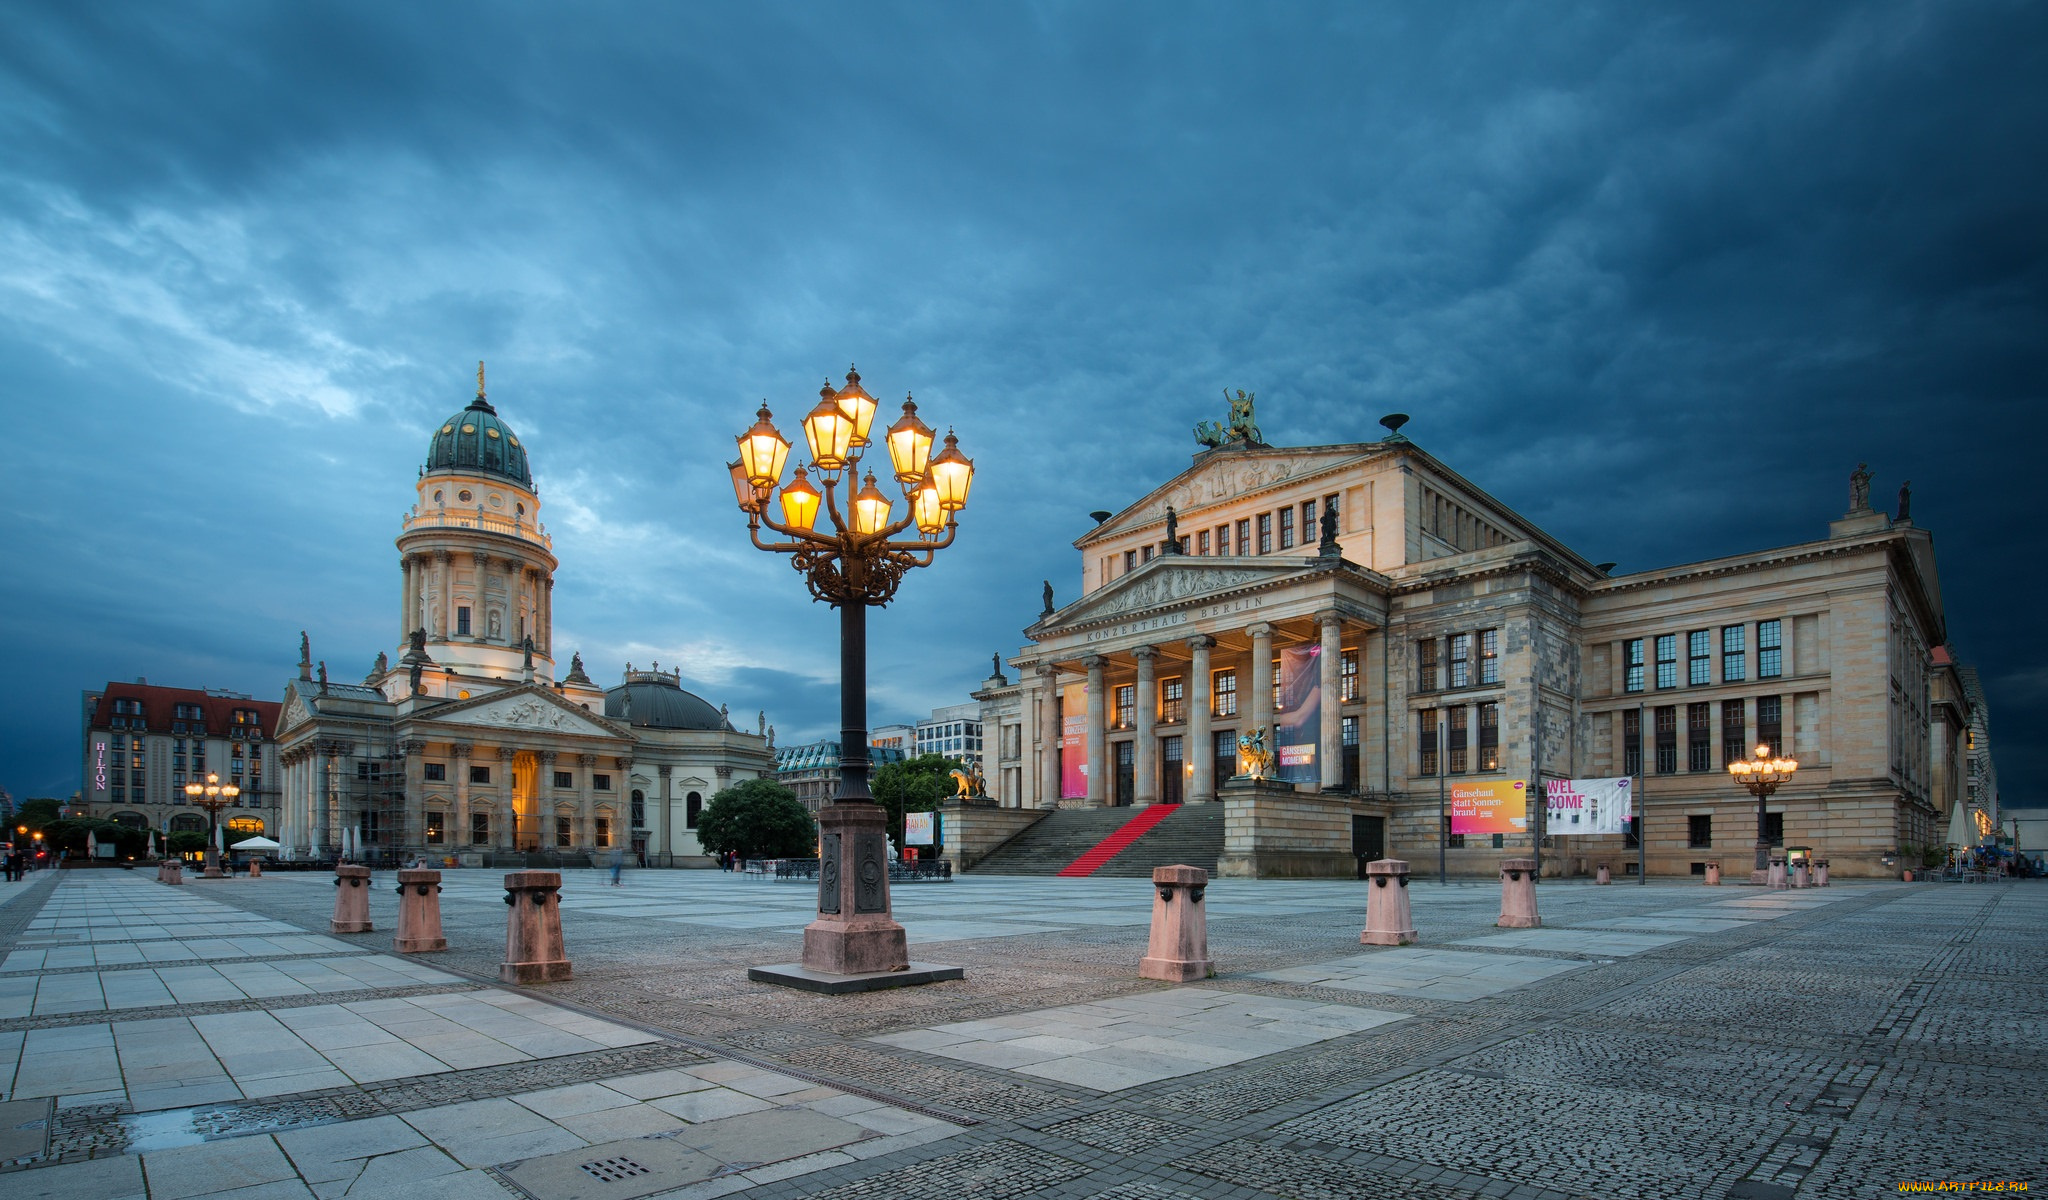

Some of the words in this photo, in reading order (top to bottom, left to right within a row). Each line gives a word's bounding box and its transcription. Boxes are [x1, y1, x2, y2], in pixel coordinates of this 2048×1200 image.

[1087, 613, 1188, 642] KONZERTHAUS
[1201, 596, 1263, 618] BERLIN
[96, 743, 106, 790] HILTON
[1453, 788, 1495, 798] Gänsehaut
[1546, 779, 1575, 794] WEL
[1453, 799, 1471, 807] statt
[1472, 798, 1504, 807] Sonnen-
[1546, 795, 1586, 809] COME
[1453, 807, 1477, 817] brand
